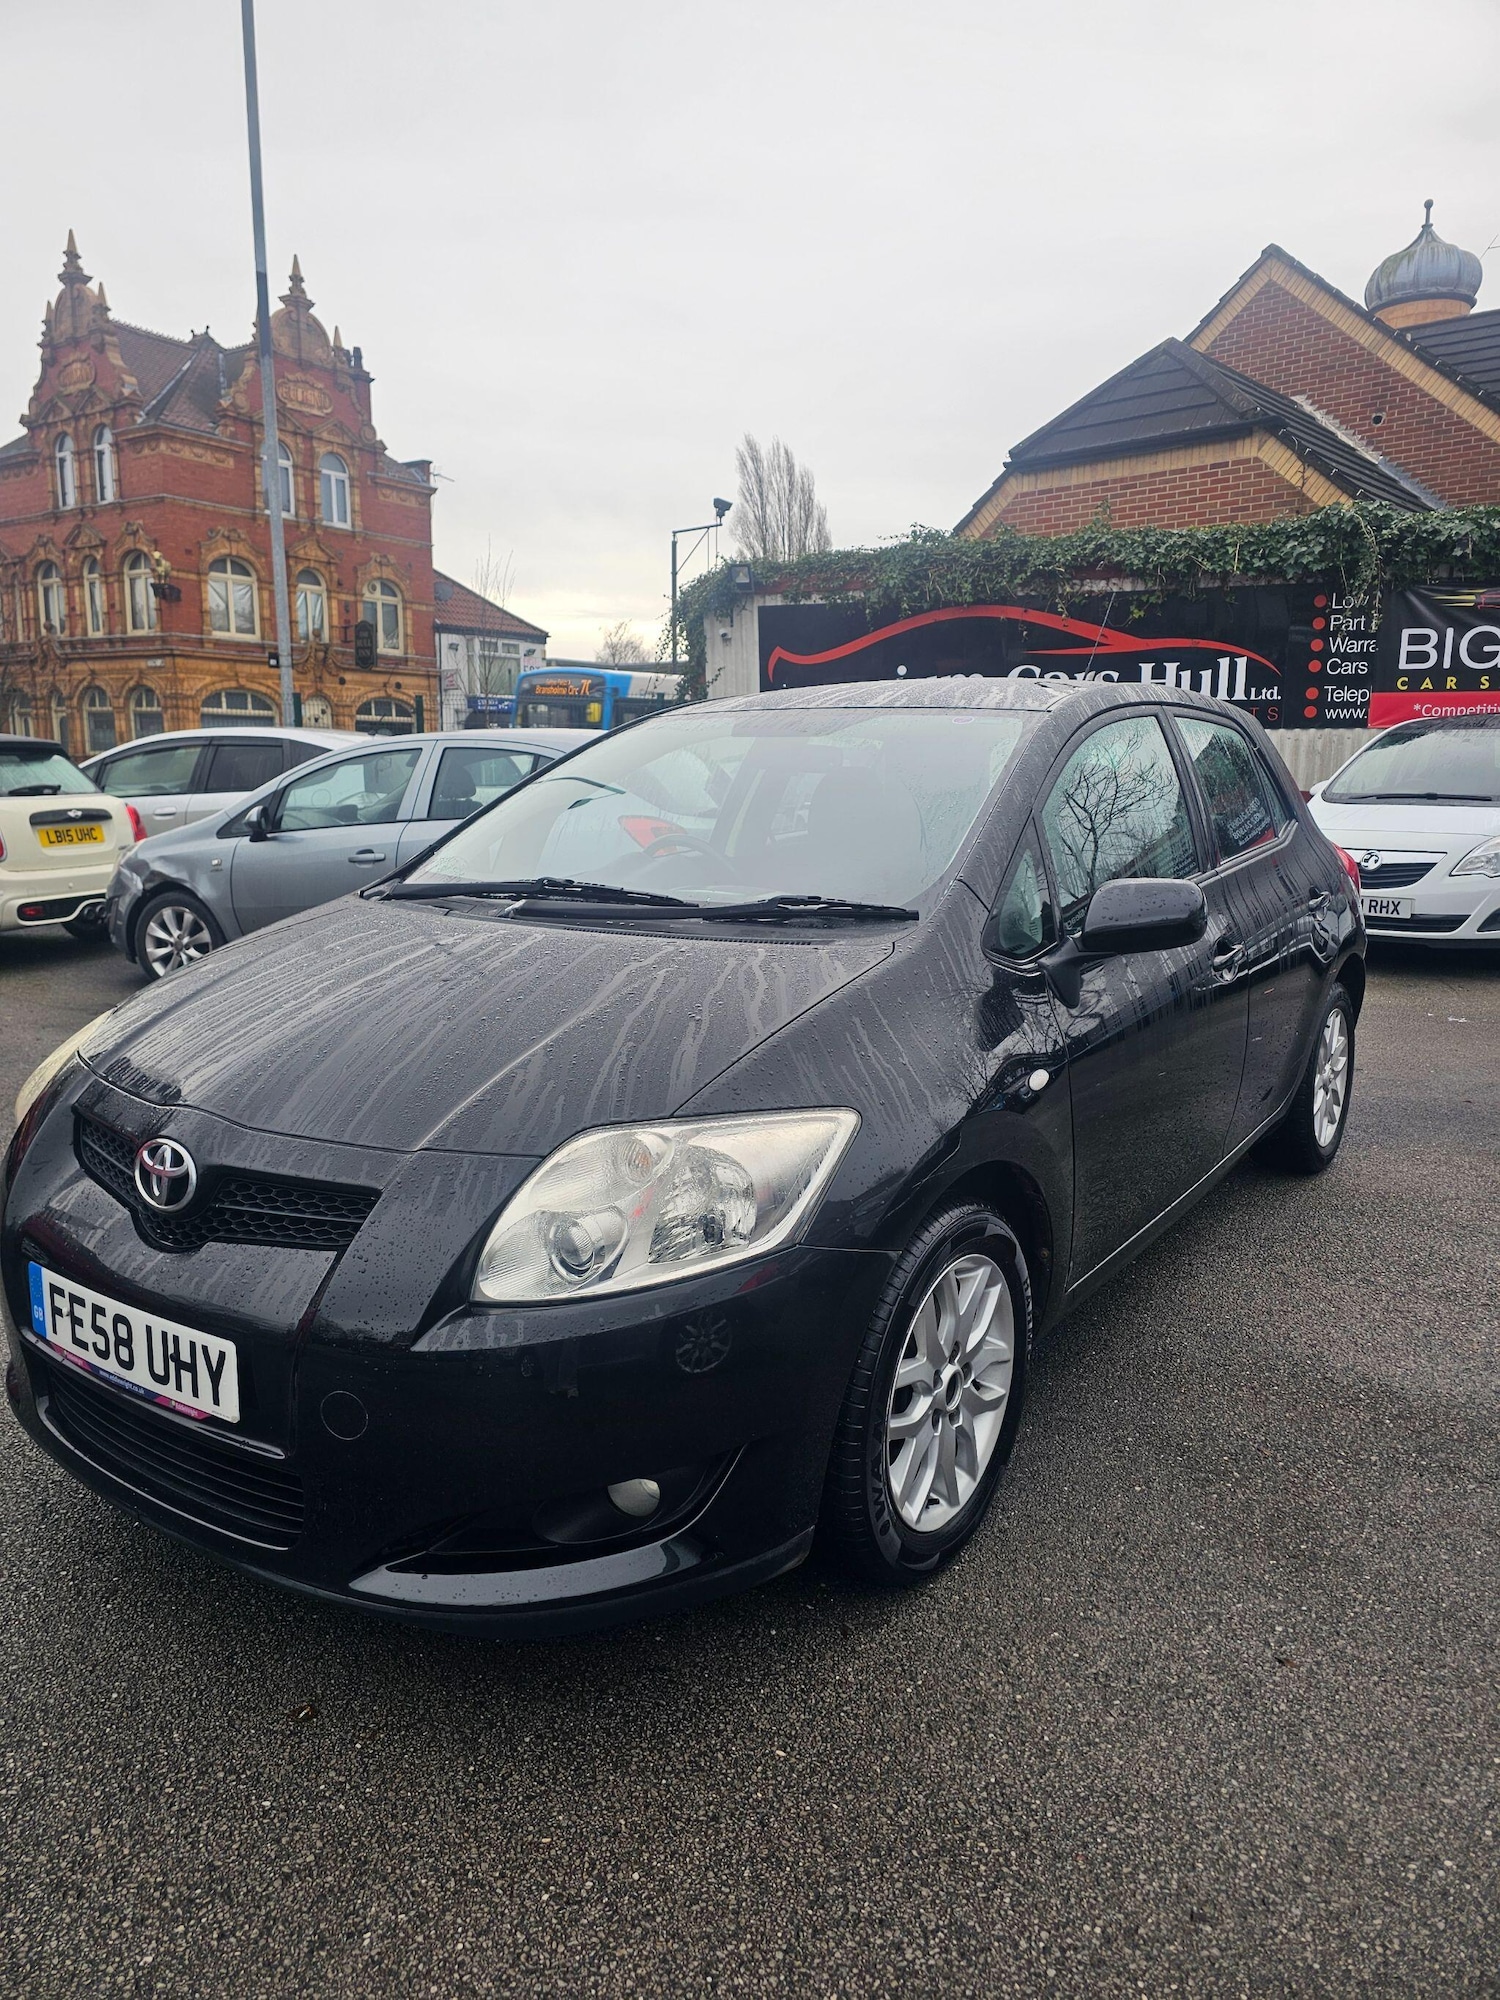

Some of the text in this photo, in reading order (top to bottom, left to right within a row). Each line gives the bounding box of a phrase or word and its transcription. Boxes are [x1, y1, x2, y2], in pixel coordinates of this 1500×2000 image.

[1329, 614, 1366, 632] Part
[1398, 625, 1500, 670] BIG
[1326, 657, 1369, 675] Cars
[1250, 686, 1282, 701] Ltd.
[1323, 685, 1372, 706] Telep
[45, 827, 98, 845] LB15 UHC
[1368, 899, 1401, 915] RHX
[48, 1282, 227, 1407] FE58 UHY
